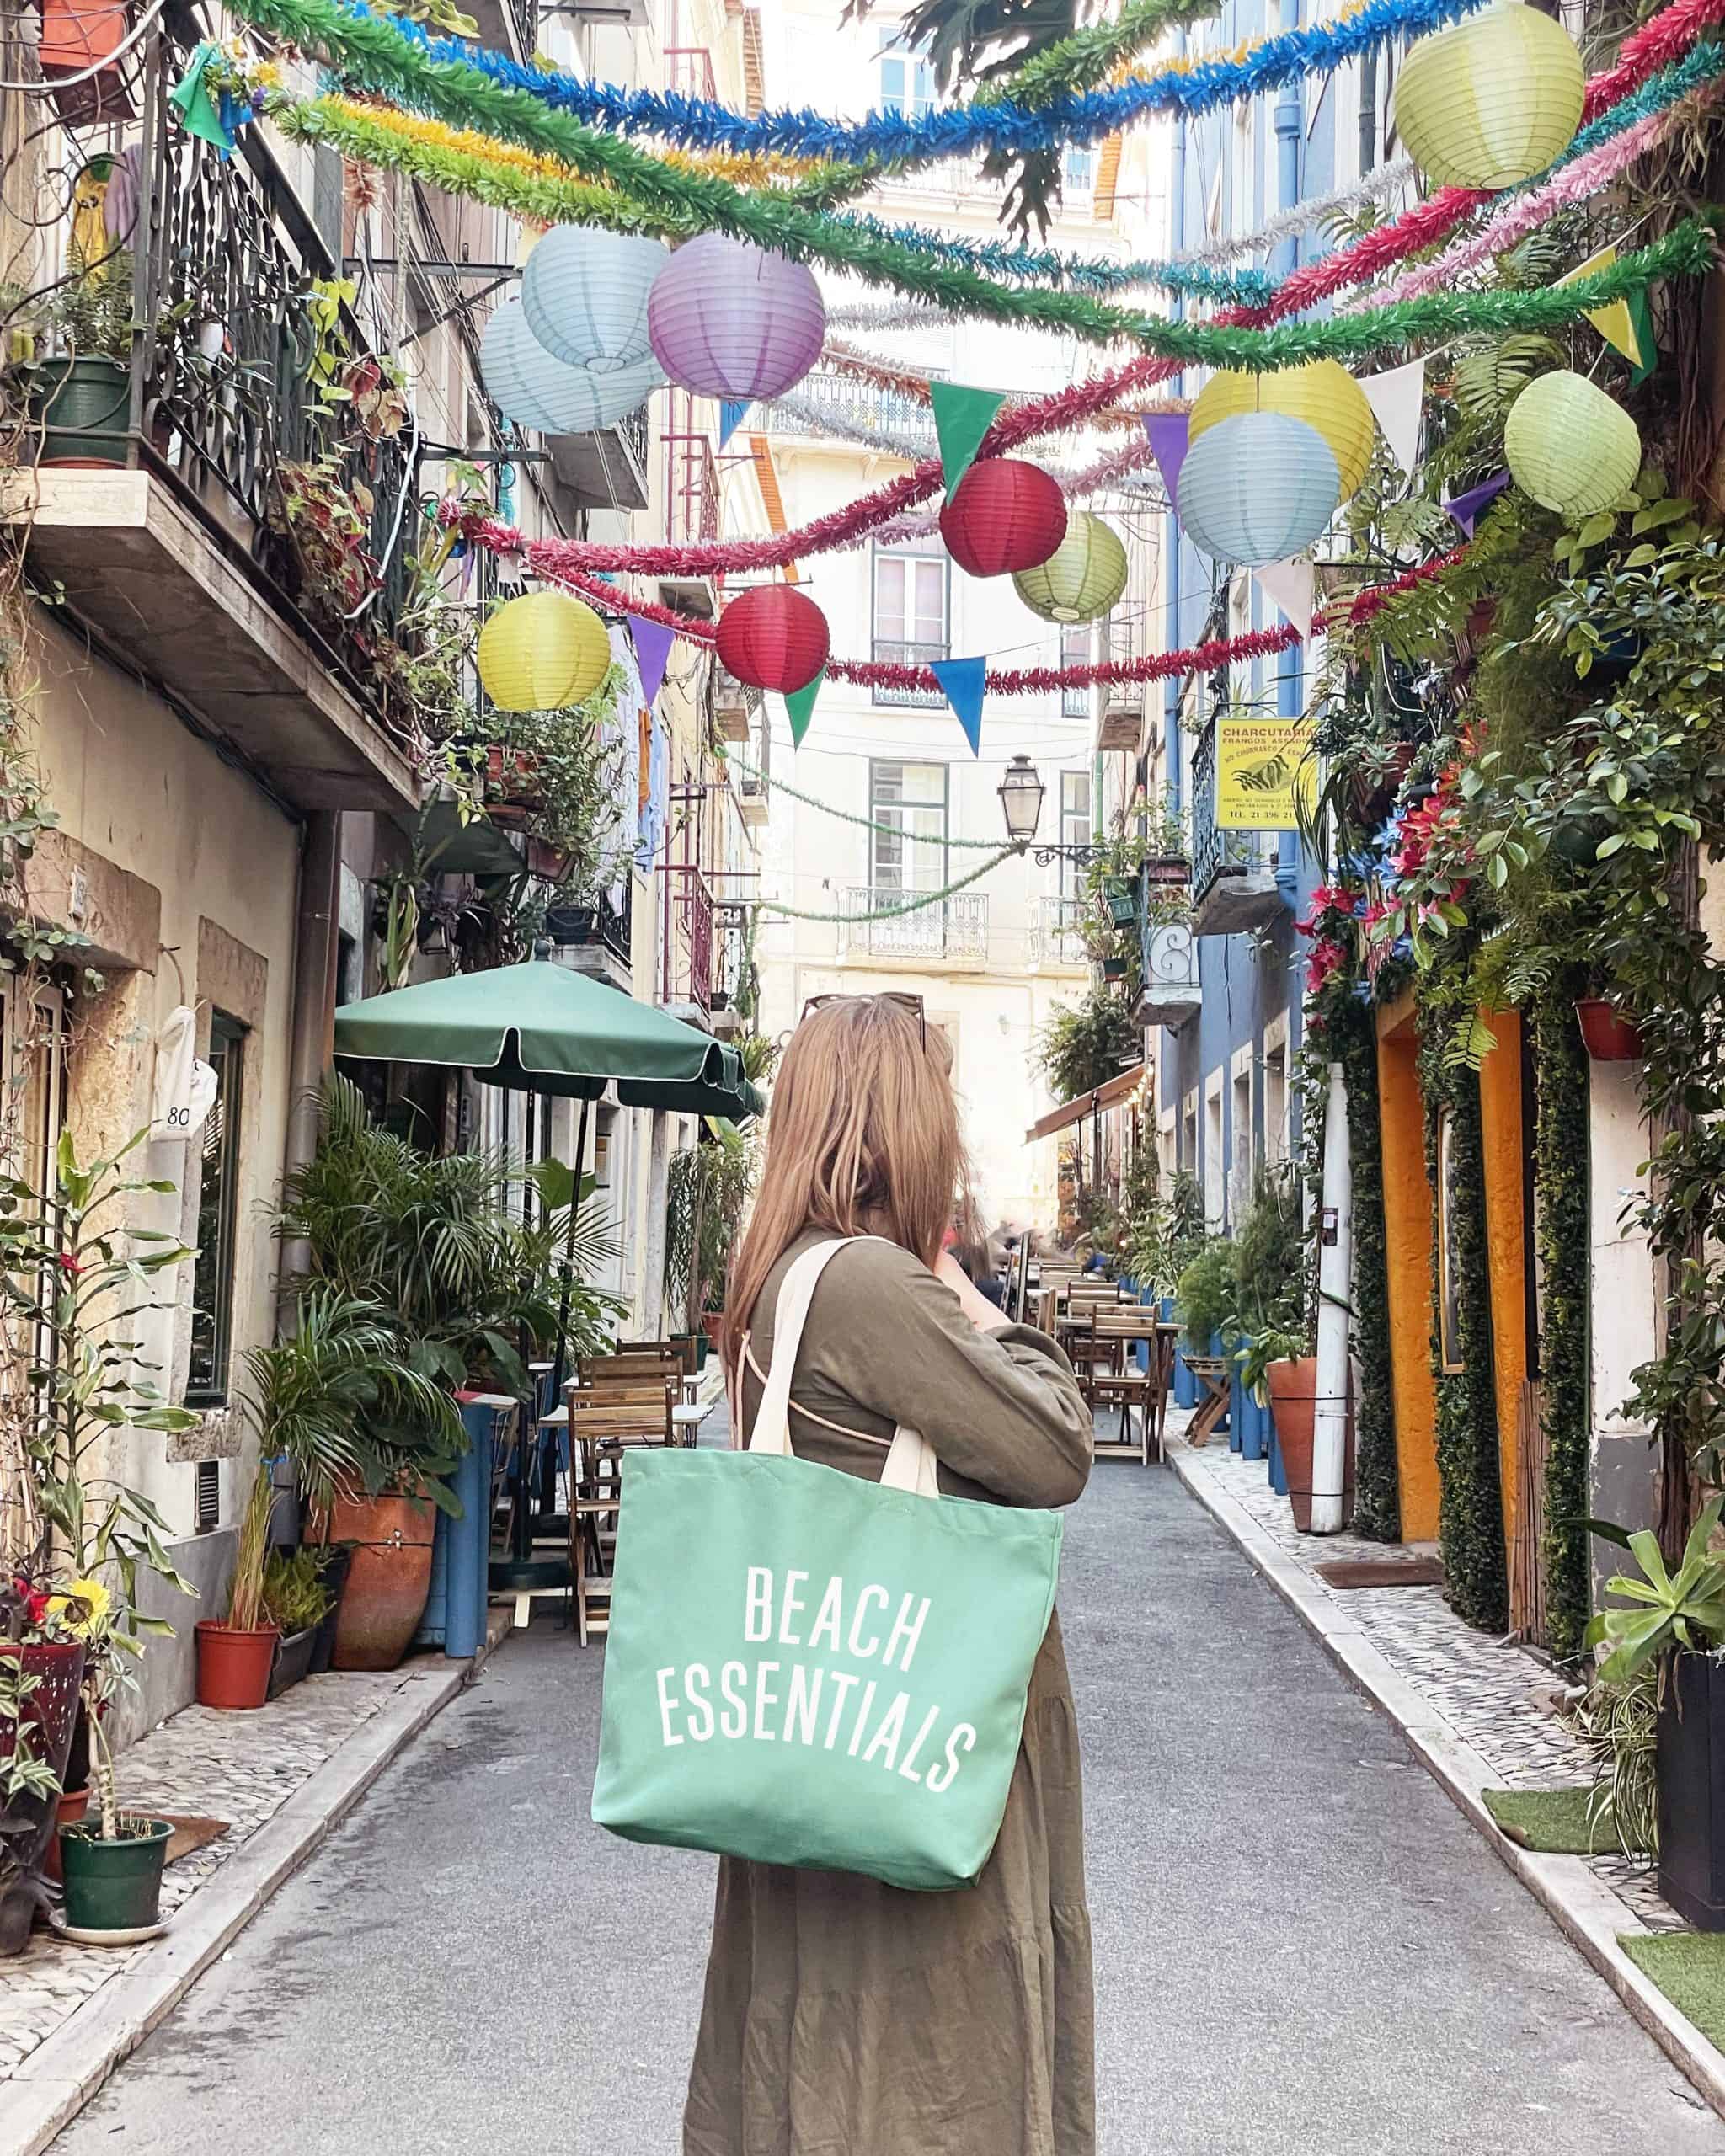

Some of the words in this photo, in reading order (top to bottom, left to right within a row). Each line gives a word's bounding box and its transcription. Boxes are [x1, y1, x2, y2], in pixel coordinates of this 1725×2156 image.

[1223, 728, 1314, 737] CHARCUTARIA
[168, 1107, 190, 1126] 80
[745, 1566, 931, 1672] BEACH
[657, 1661, 976, 1793] ESSENTIALS
